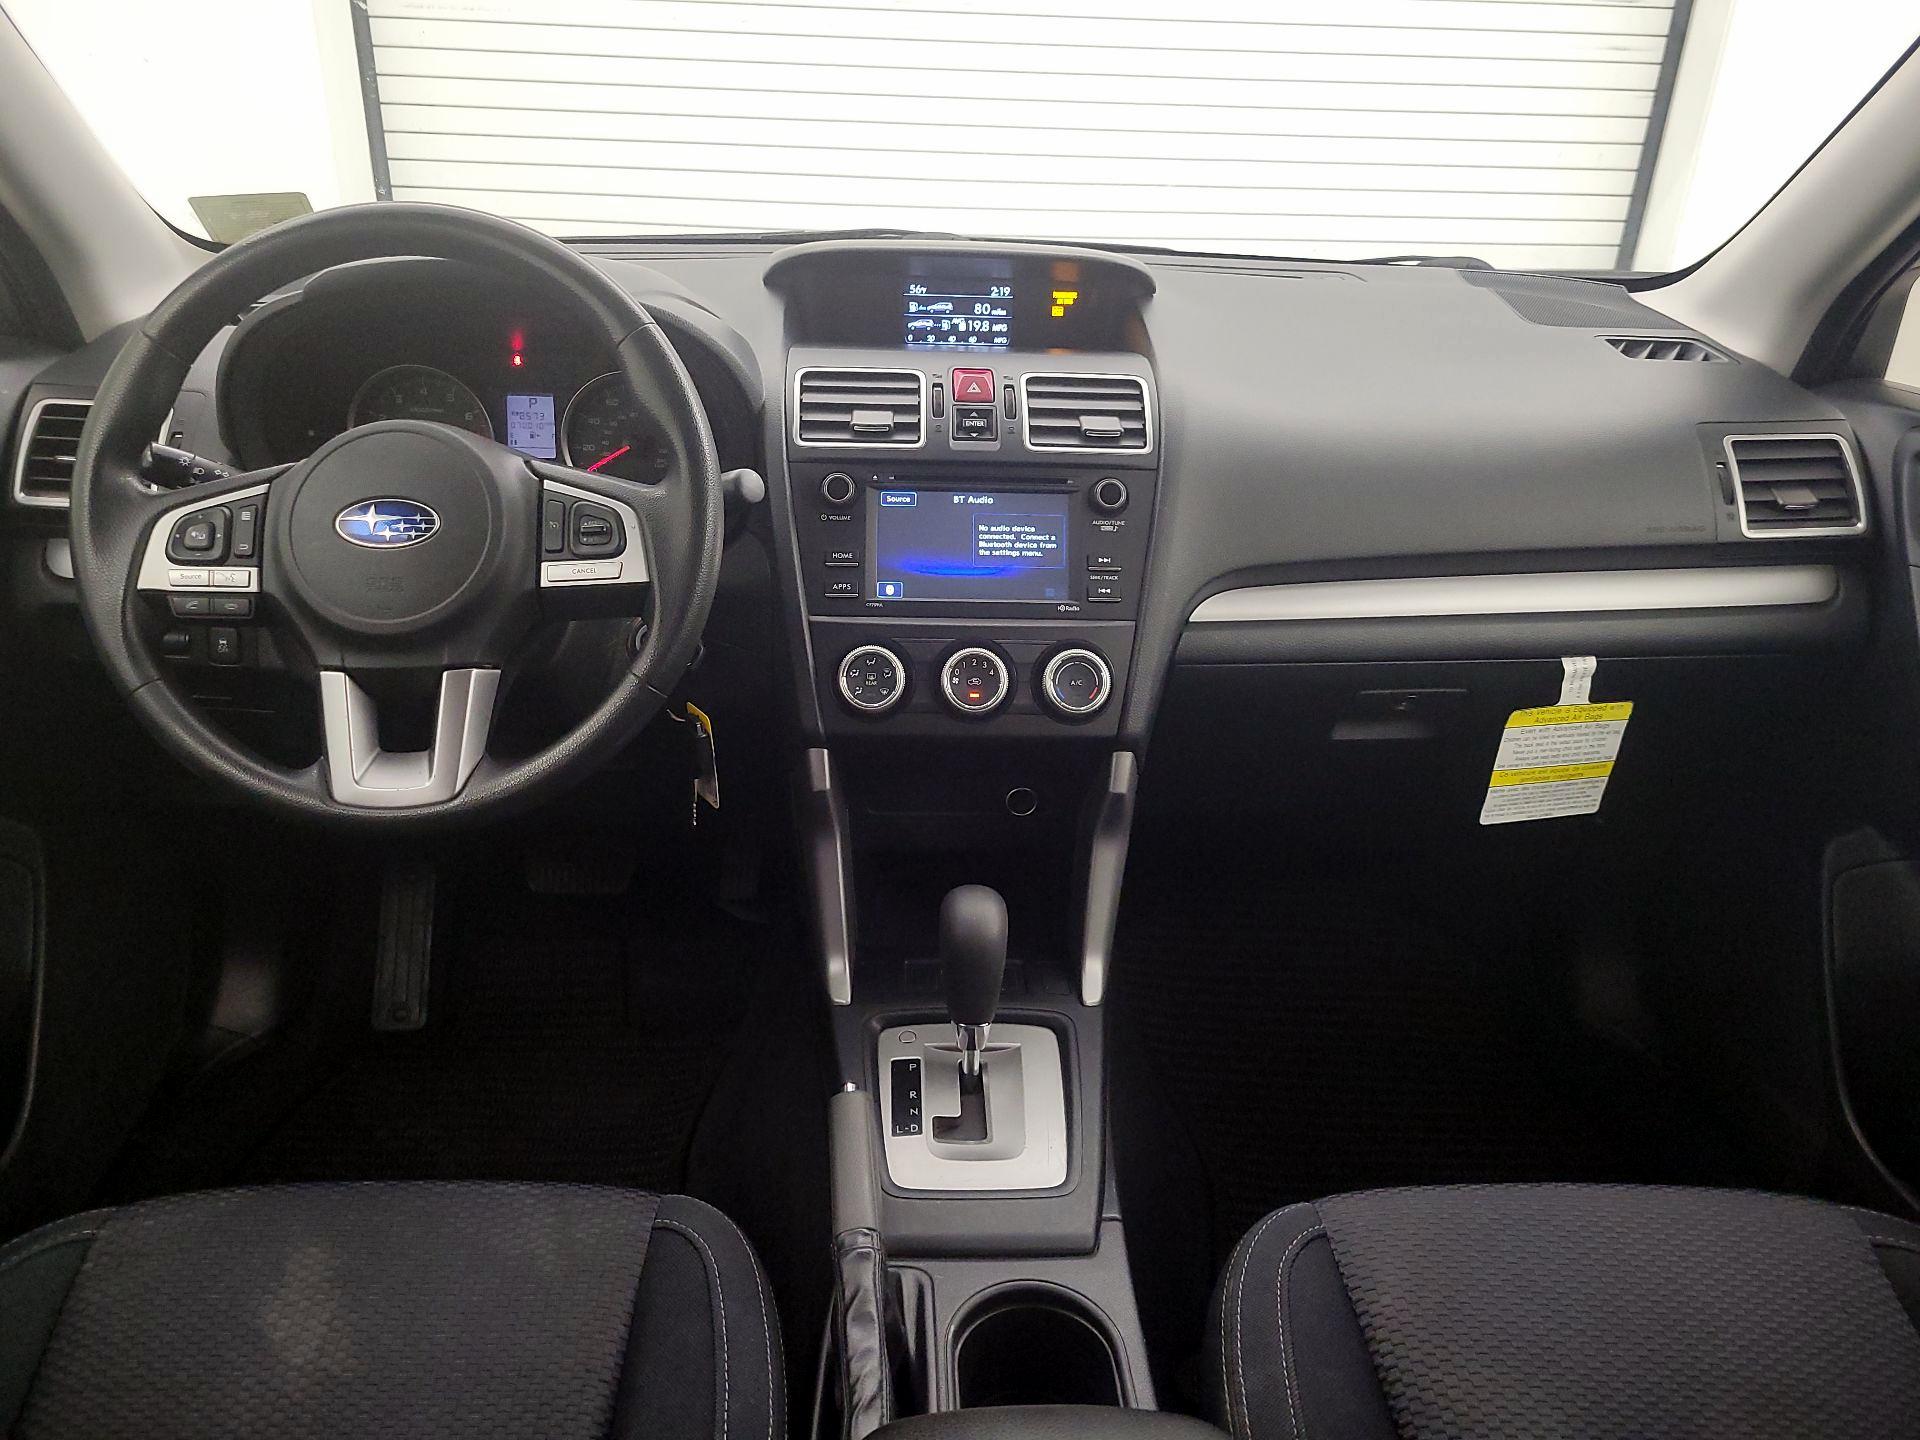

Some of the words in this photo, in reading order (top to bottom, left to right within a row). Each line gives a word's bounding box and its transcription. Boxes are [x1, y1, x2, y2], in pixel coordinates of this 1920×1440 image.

[990, 286, 1011, 296] 2:19
[974, 303, 991, 315] 80
[968, 320, 990, 332] 19.8
[529, 398, 538, 408] P
[886, 495, 911, 503] Source
[953, 495, 965, 503] BT
[967, 495, 994, 504] Audio
[992, 549, 1020, 557] settings
[909, 1063, 917, 1071] P
[909, 1090, 917, 1099] R
